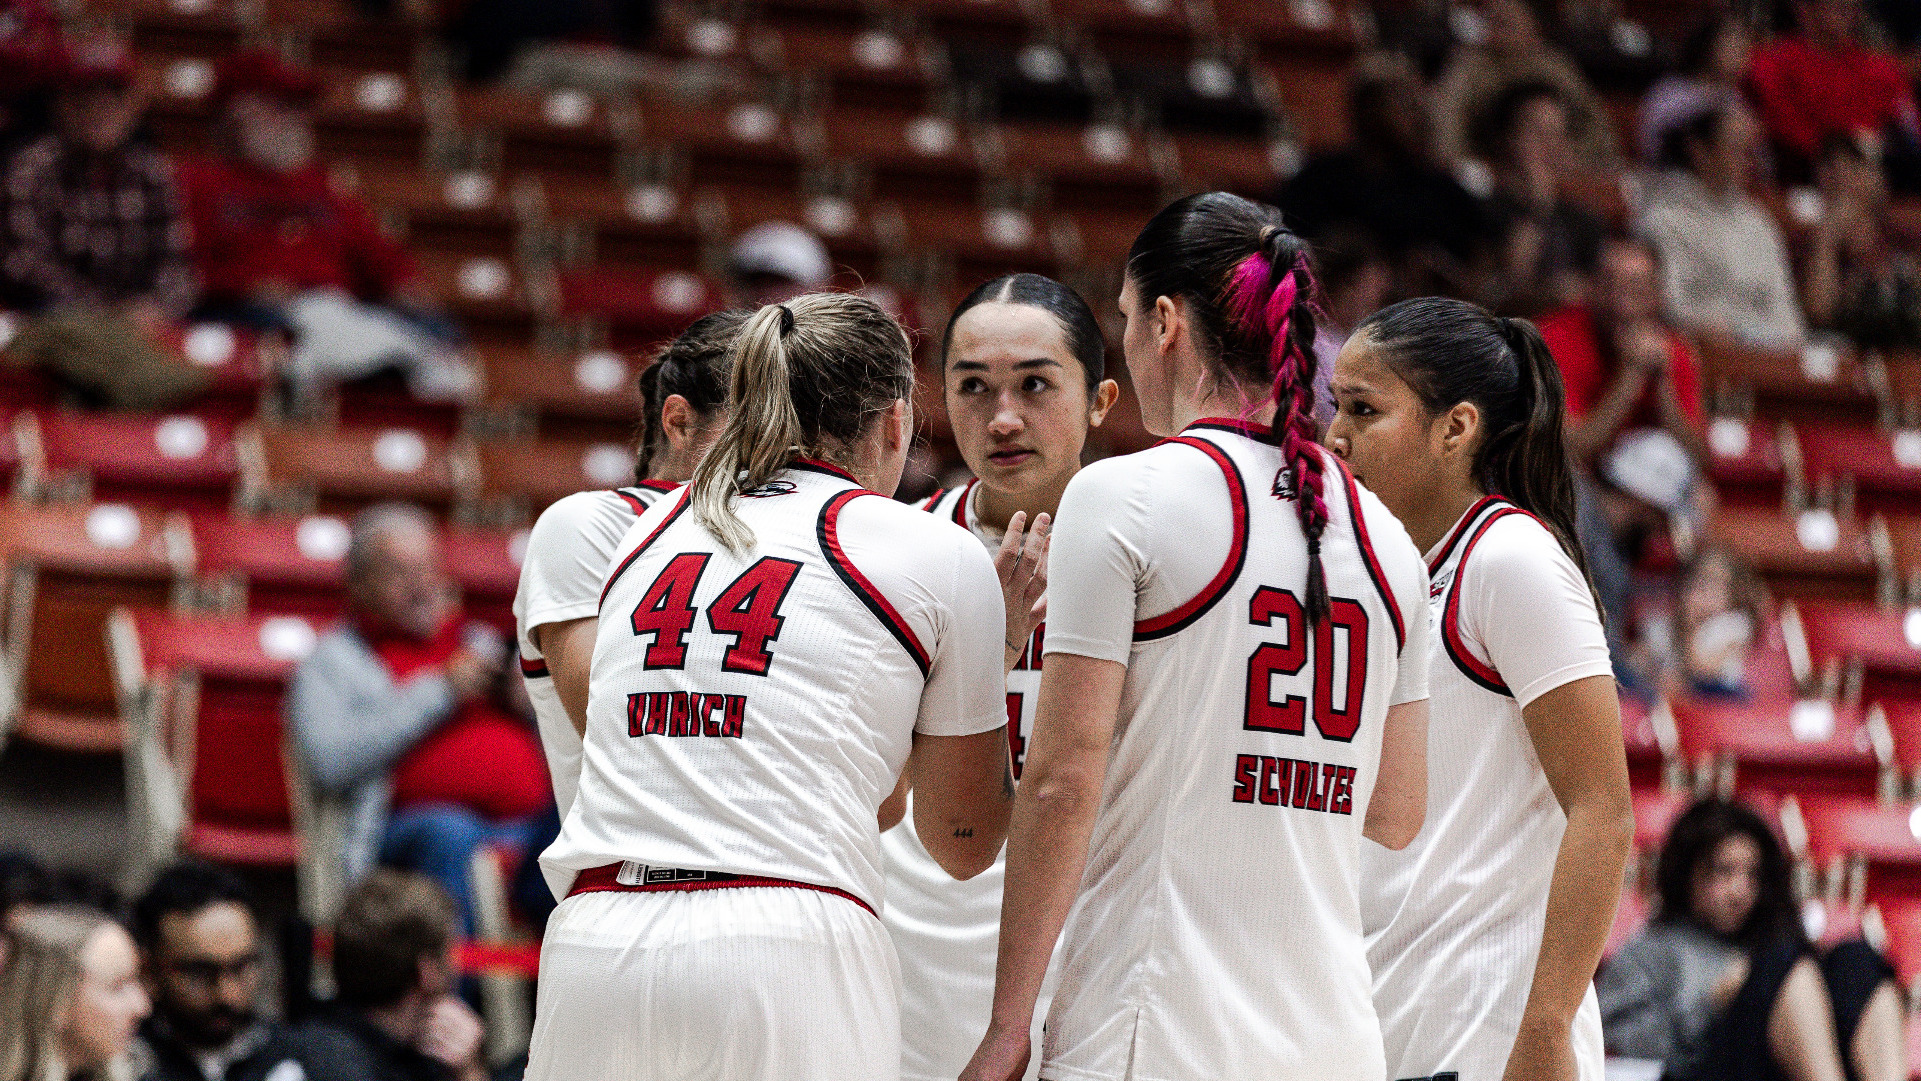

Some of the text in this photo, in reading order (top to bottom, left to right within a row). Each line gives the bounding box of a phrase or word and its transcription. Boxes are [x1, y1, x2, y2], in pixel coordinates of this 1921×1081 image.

[630, 552, 805, 677] 44
[1243, 585, 1369, 743] 20
[627, 690, 747, 739] UHRICH
[1232, 754, 1357, 815] SCHOLTES
[953, 827, 973, 839] 444
